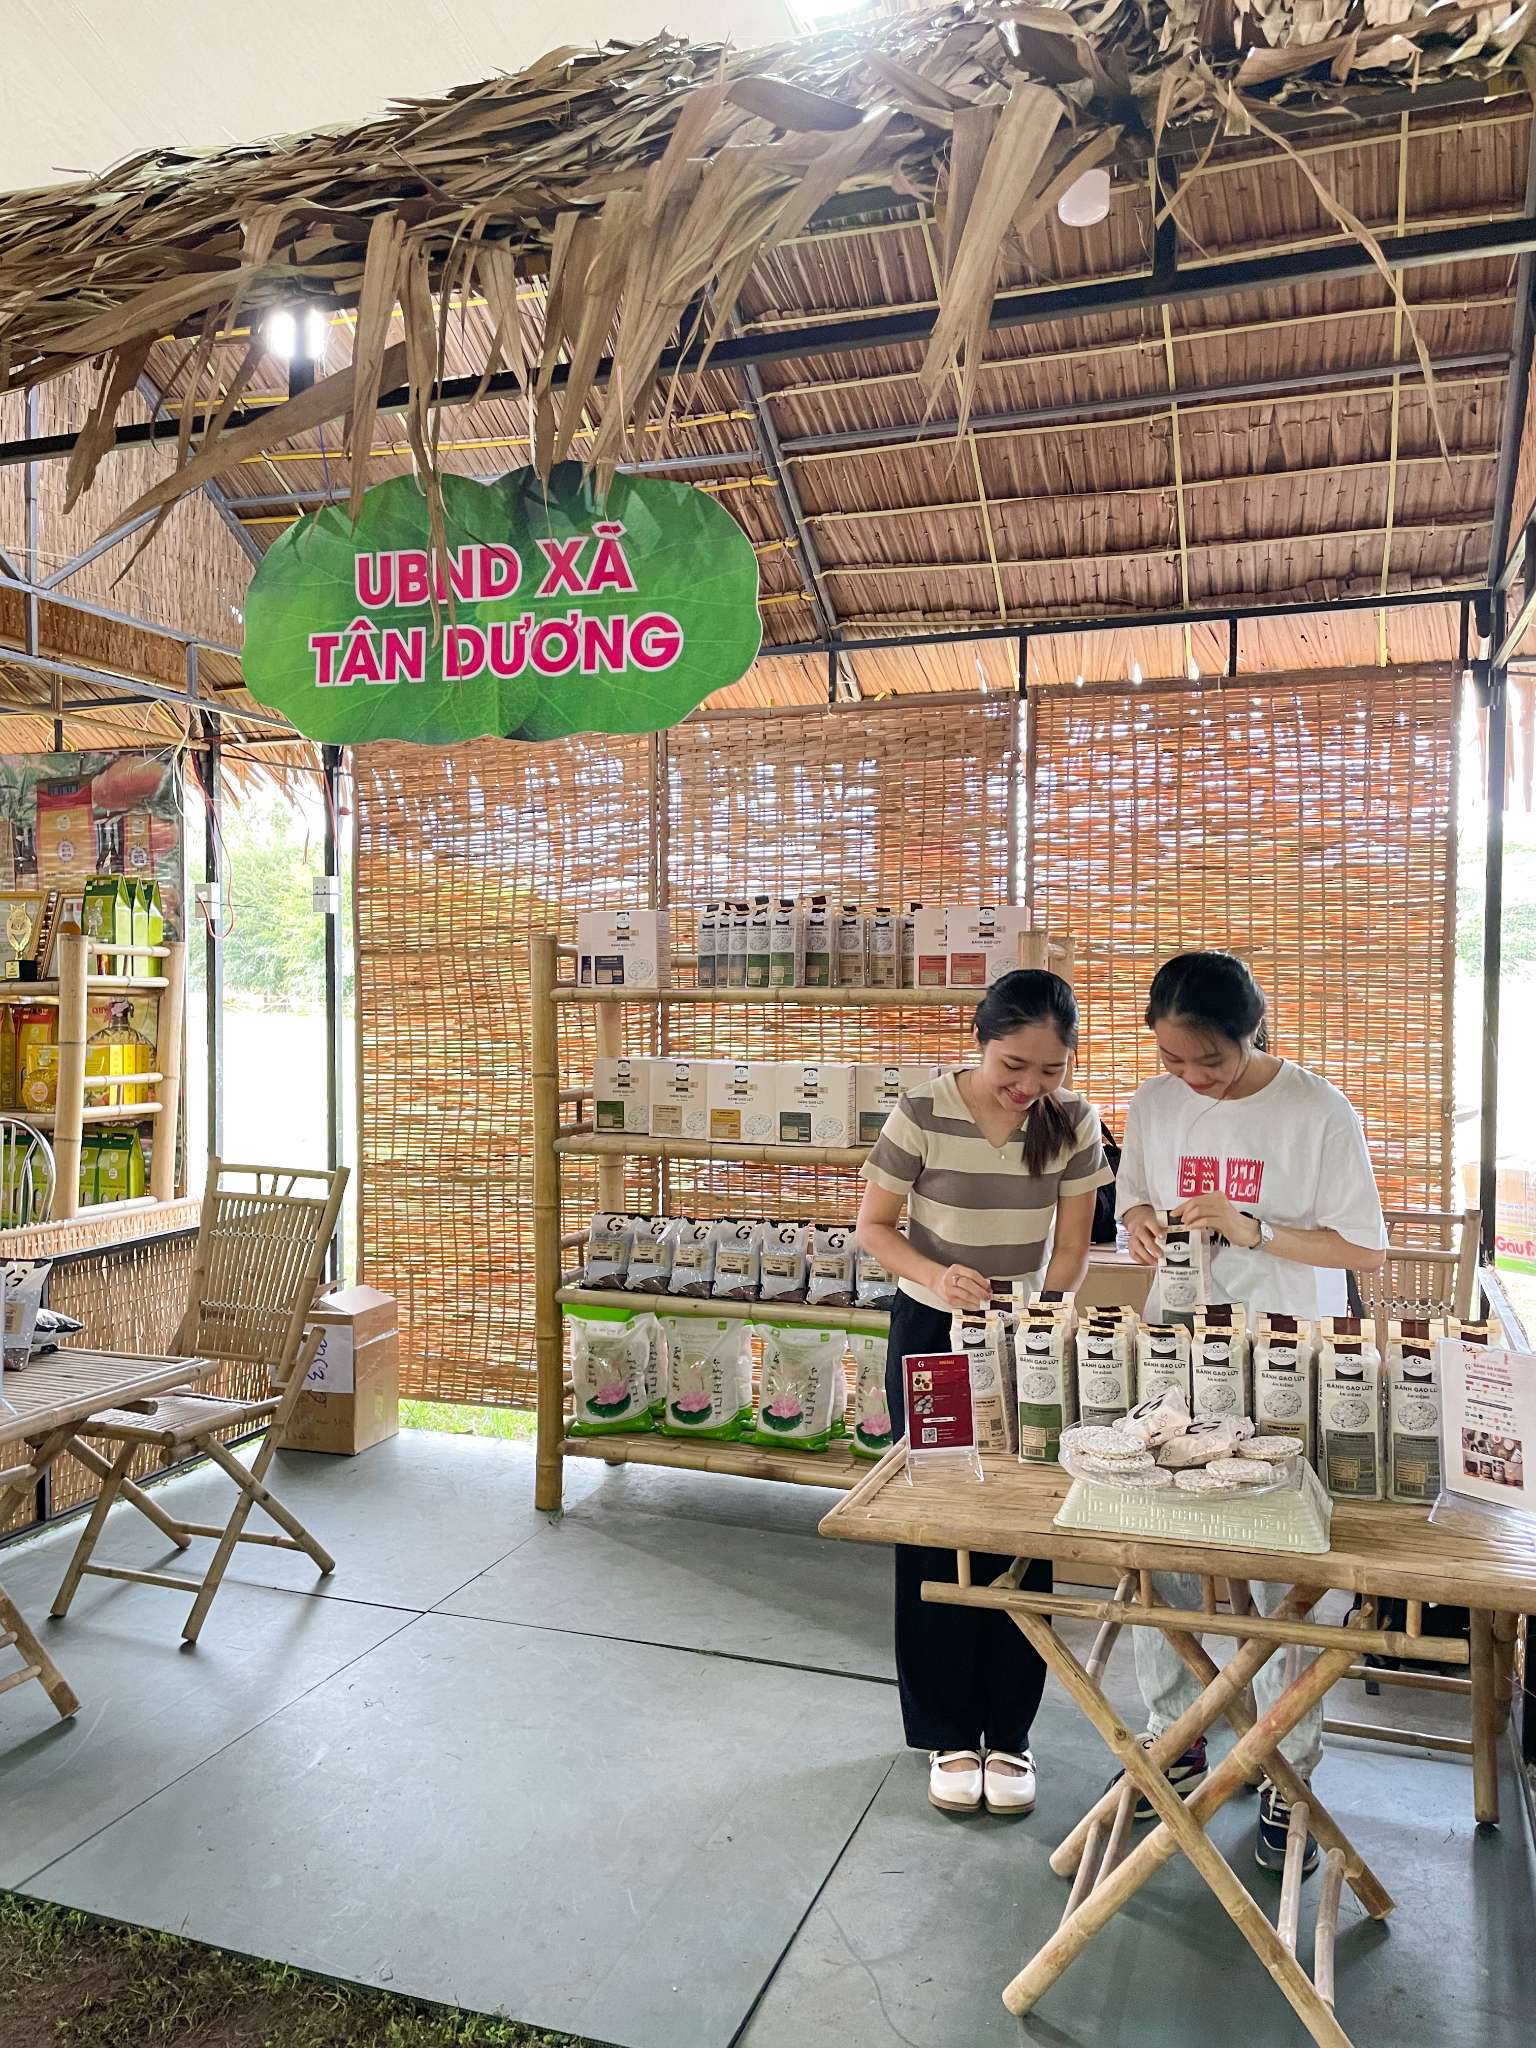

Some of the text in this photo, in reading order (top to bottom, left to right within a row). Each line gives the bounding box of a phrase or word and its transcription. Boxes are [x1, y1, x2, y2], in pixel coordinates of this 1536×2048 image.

[355, 520, 637, 609] UBND XÃ
[309, 609, 683, 687] TÂN DƯƠNG
